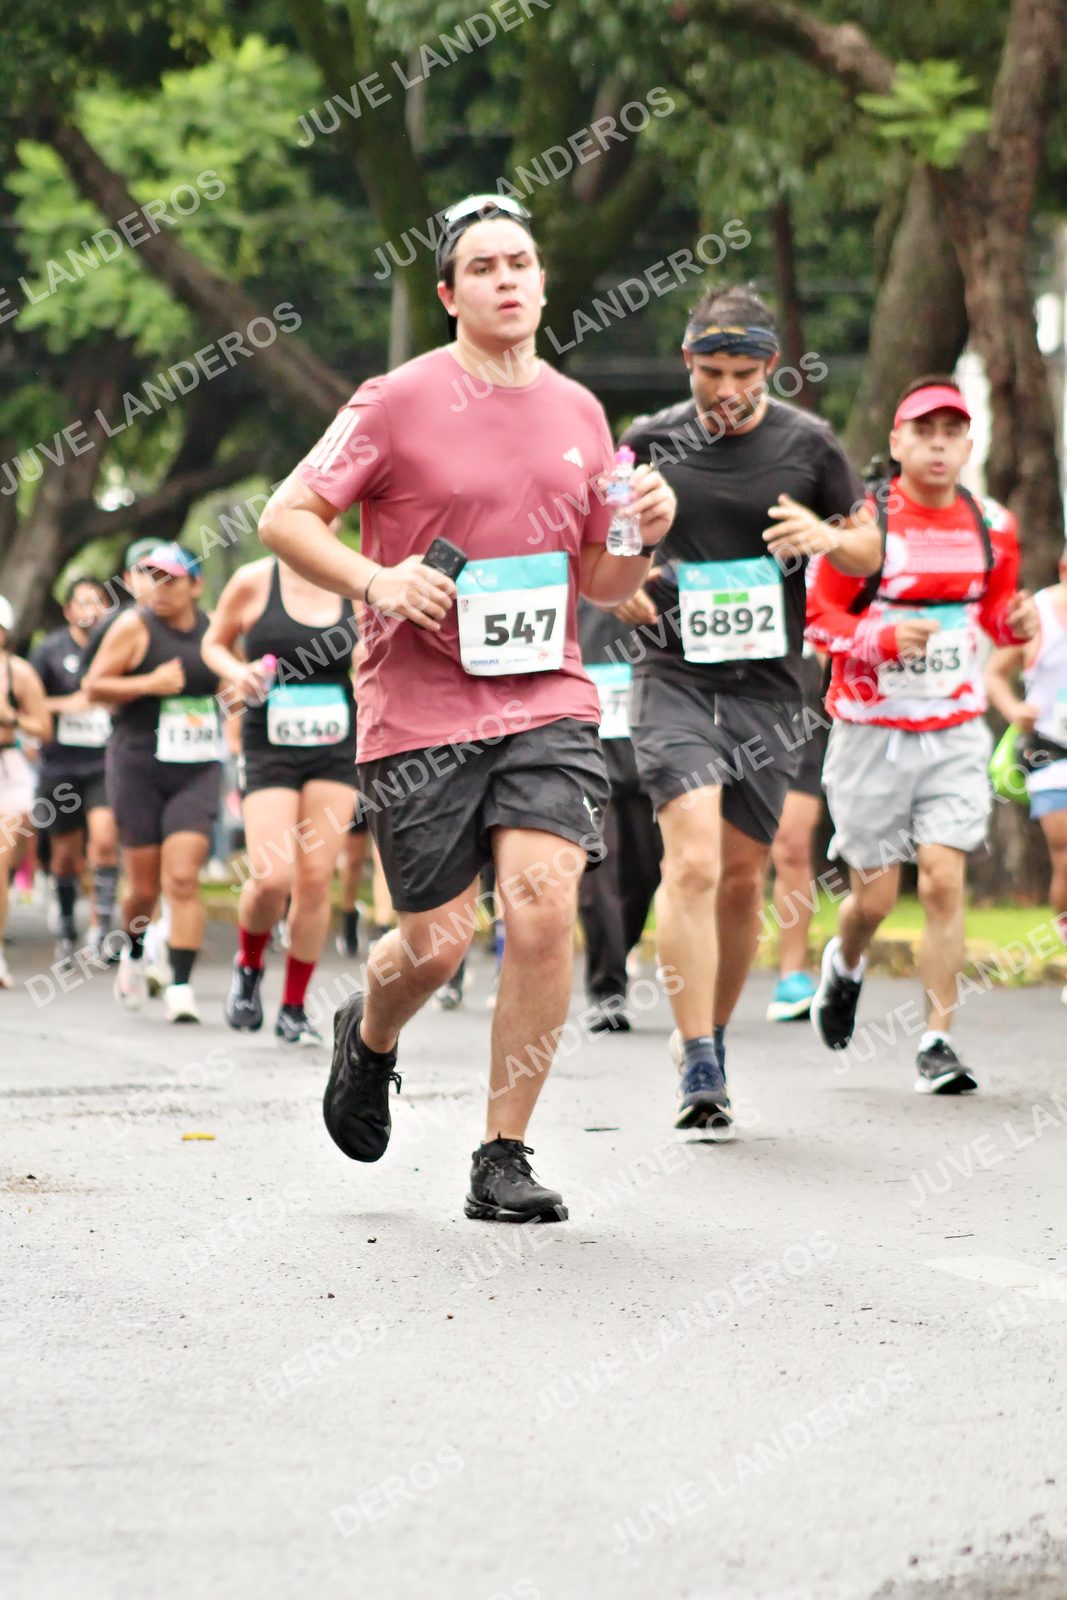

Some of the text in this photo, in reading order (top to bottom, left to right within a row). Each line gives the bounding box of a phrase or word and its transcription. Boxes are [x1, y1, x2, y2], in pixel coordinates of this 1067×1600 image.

[483, 608, 557, 646] 547
[688, 605, 775, 638] 6892
[276, 720, 341, 740] 6340
